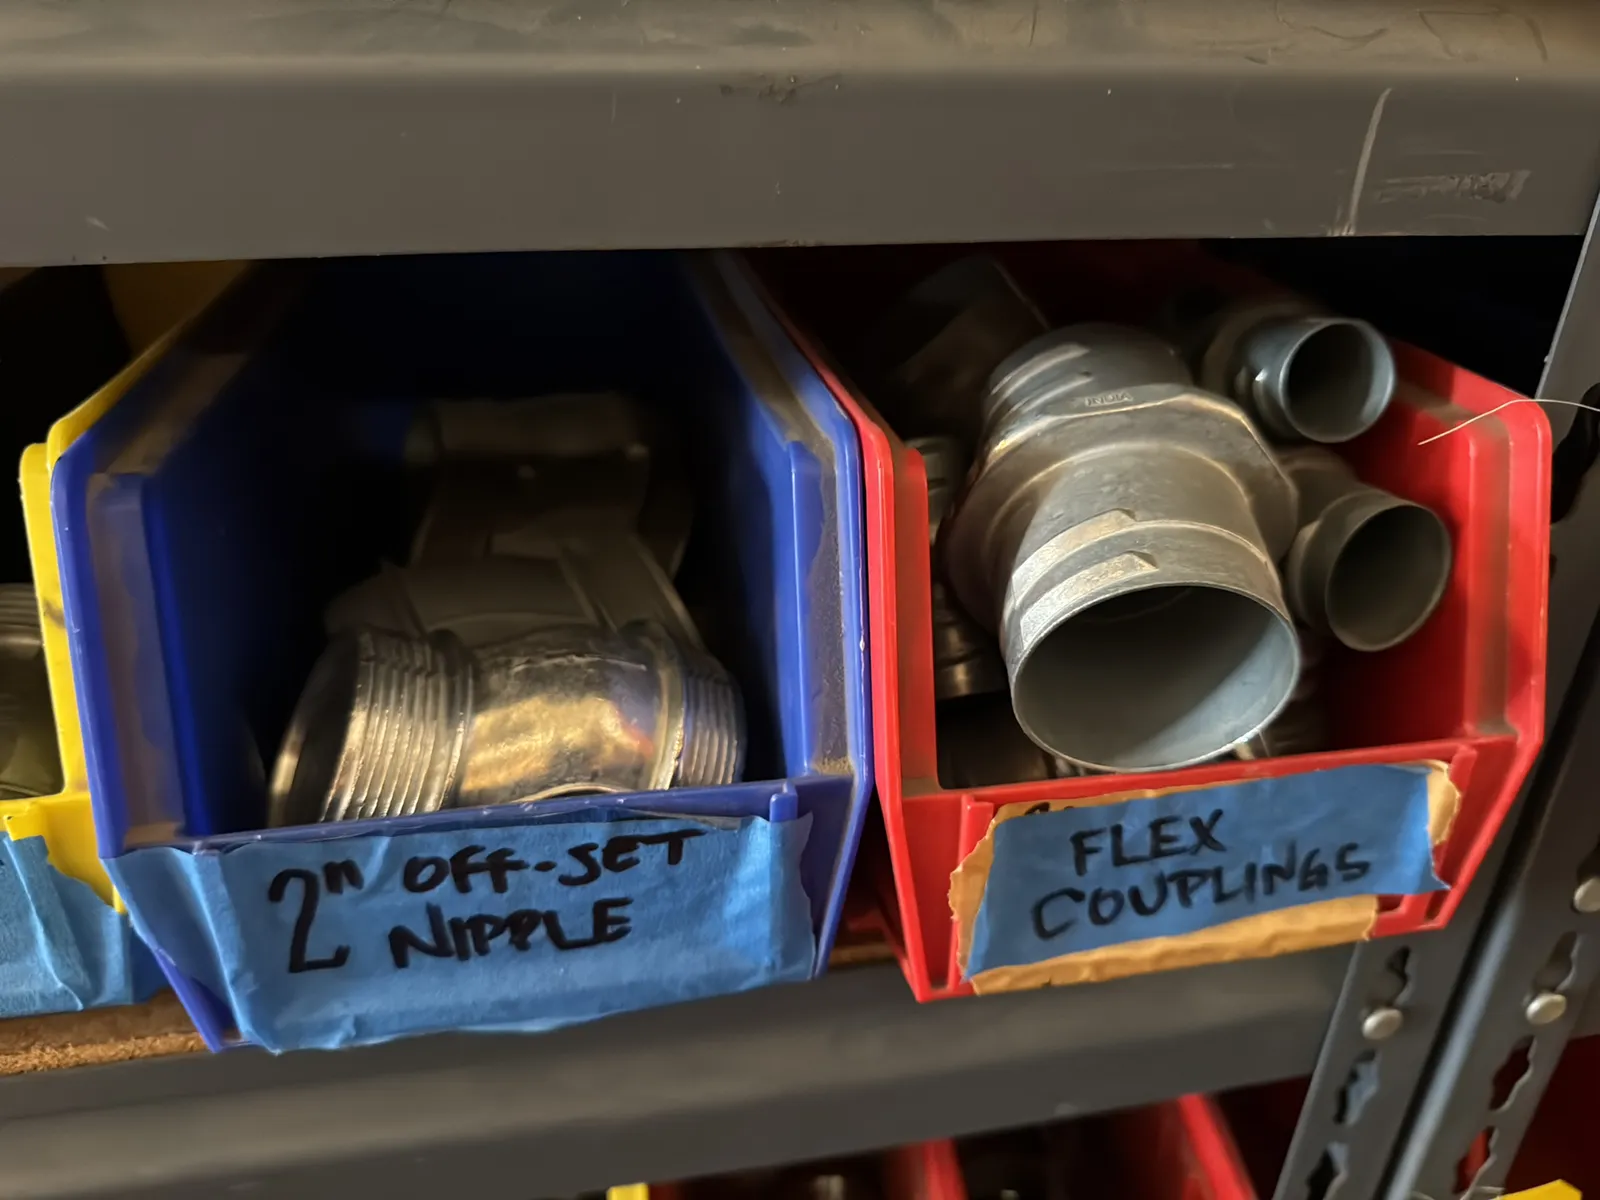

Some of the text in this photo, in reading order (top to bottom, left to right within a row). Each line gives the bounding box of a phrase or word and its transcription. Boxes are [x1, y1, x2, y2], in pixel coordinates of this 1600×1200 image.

[1069, 808, 1228, 877] FLEX
[1030, 842, 1371, 940] COUPLINGS
[387, 897, 635, 969] NIPPLE
